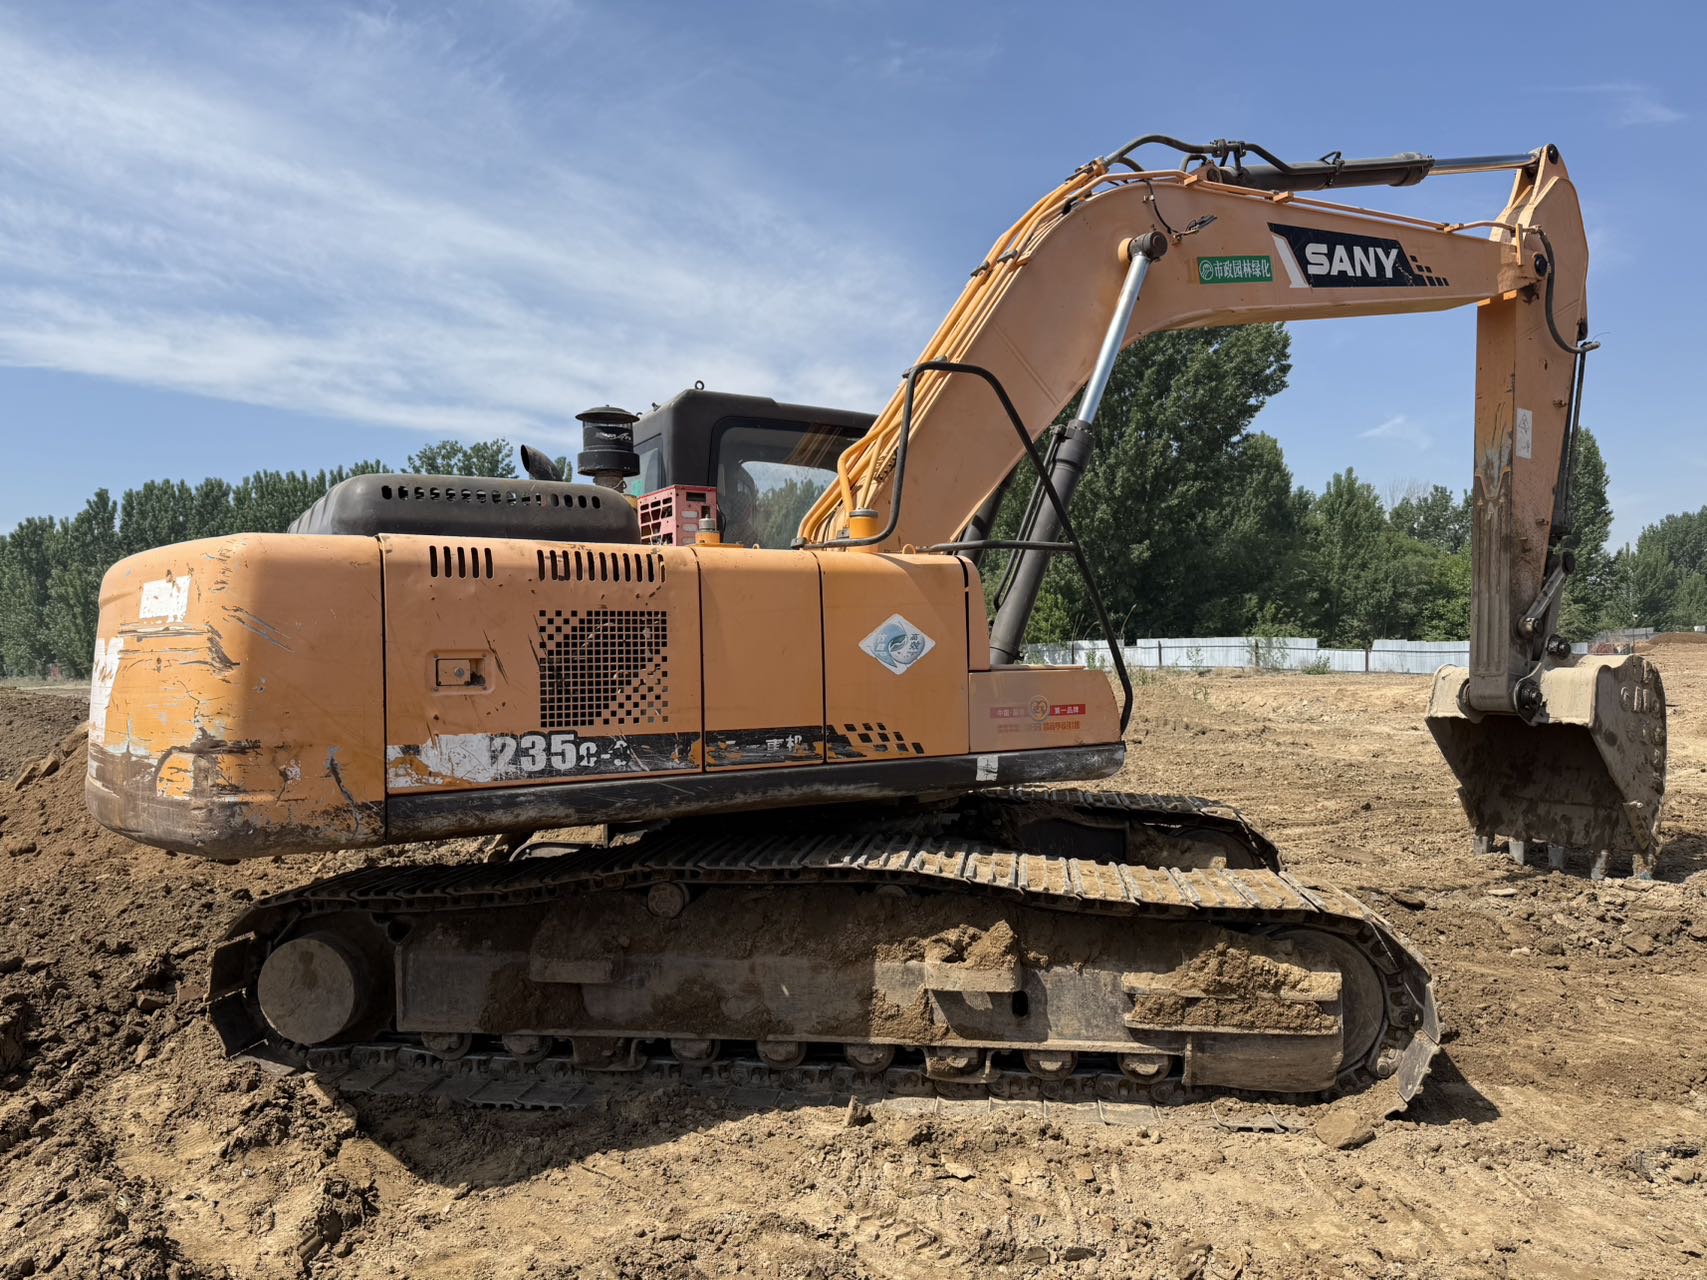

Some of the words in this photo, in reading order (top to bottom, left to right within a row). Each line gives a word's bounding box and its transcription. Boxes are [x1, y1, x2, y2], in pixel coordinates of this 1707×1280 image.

[1213, 259, 1271, 279] 市政园林绿化
[1305, 242, 1399, 279] SANY
